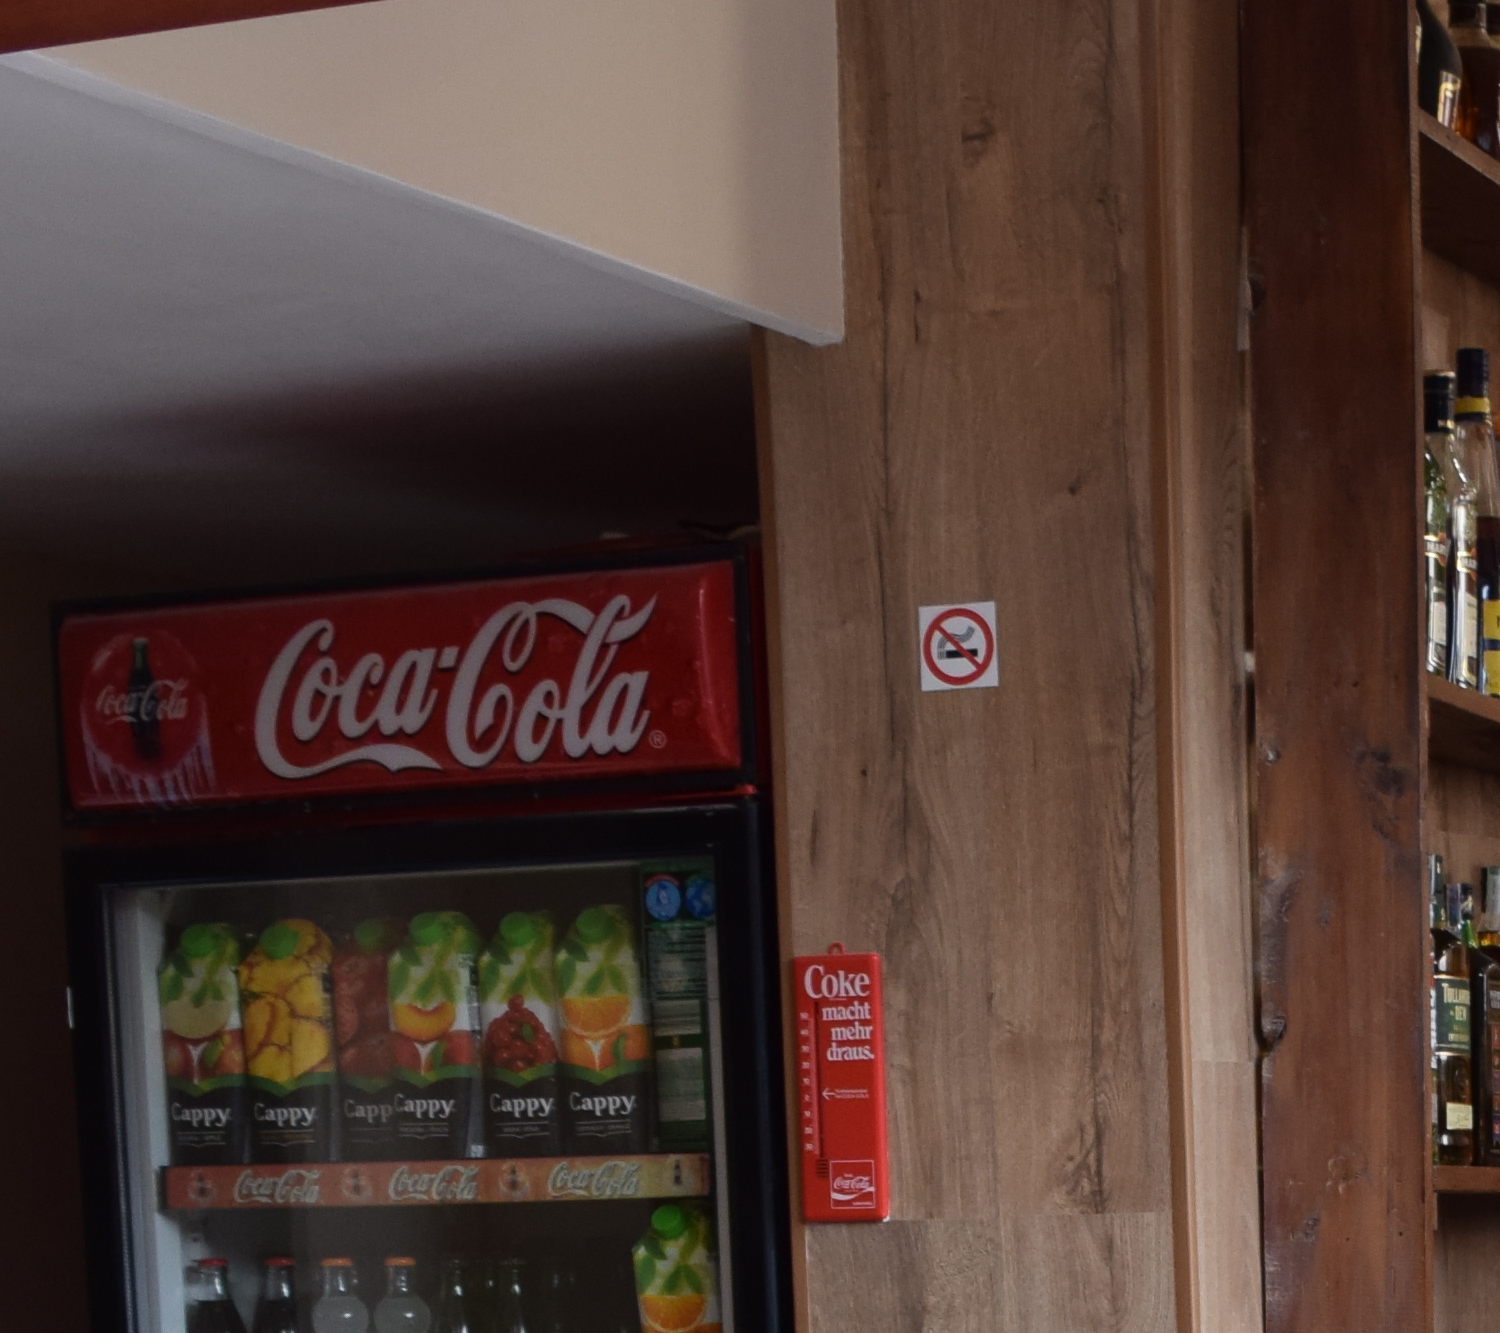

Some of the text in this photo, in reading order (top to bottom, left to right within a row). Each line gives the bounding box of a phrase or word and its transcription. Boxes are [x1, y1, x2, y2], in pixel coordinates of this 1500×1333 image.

[254, 592, 657, 779] Coca-Cola
[95, 679, 190, 725] Coca-Cola
[804, 964, 871, 999] Coke
[822, 1001, 871, 1020] macht
[831, 1021, 873, 1041] mehr
[826, 1042, 875, 1061] draus.
[172, 1102, 230, 1128] Cappy
[254, 1102, 316, 1128] Cappy
[394, 1093, 454, 1120] Cappy
[490, 1093, 554, 1118] Cappy
[569, 1091, 635, 1117] Cappy
[234, 1169, 321, 1204] Coca-Cola
[389, 1165, 480, 1201] Coca-Cola
[548, 1161, 641, 1198] Coca-Cola
[833, 1176, 871, 1191] Coca-Cola
